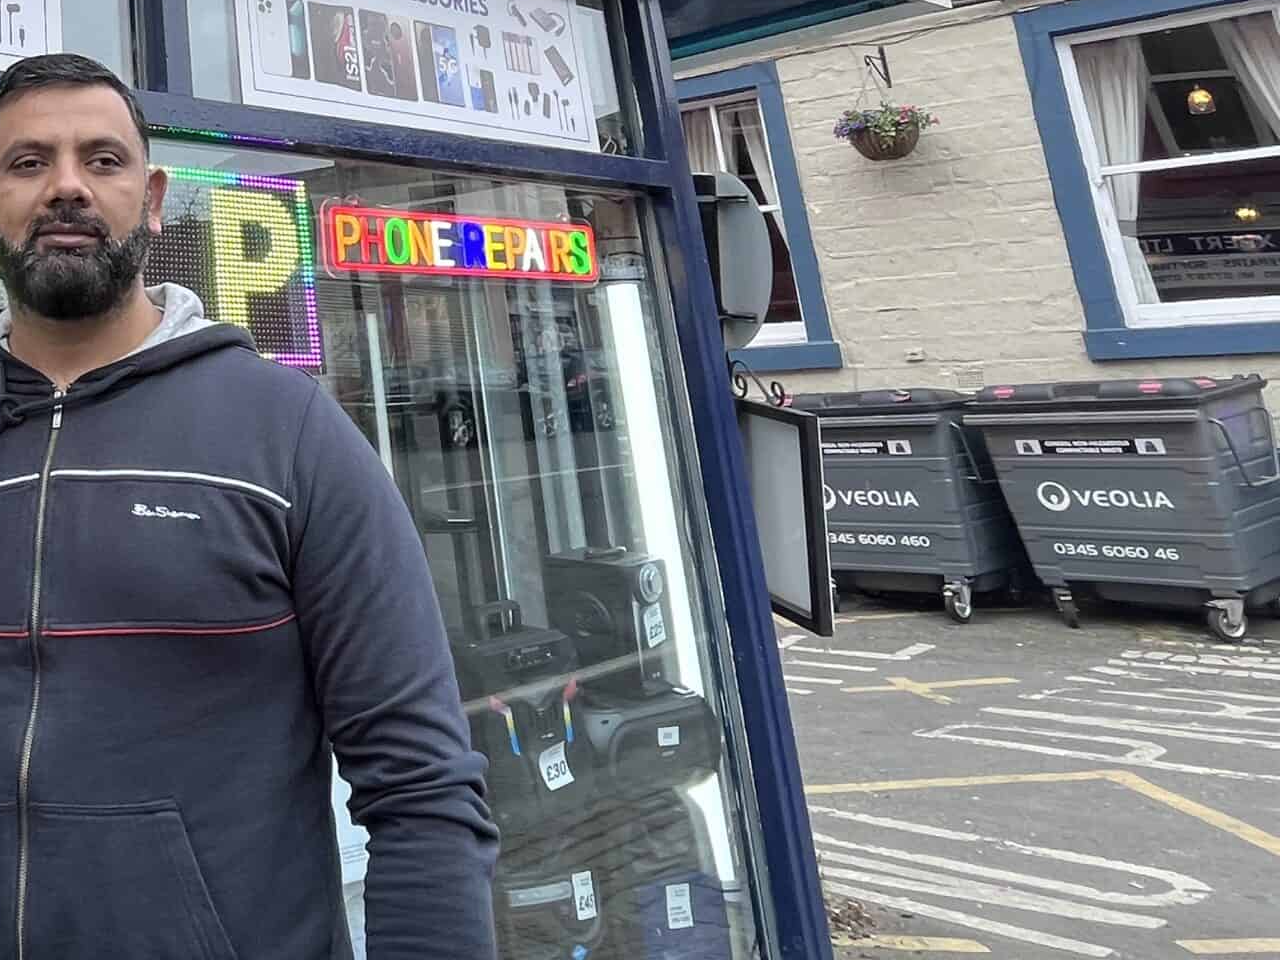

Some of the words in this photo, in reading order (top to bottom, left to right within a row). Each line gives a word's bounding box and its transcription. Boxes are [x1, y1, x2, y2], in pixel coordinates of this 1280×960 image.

[335, 214, 455, 268] PHONE
[461, 220, 590, 276] REPAIRS
[837, 490, 920, 507] VEOLIA
[1071, 489, 1175, 509] VEOLIA
[828, 532, 856, 545] 345
[858, 533, 897, 546] 6060
[900, 535, 931, 548] 460
[1053, 542, 1099, 557] 0345
[1102, 545, 1149, 559] 6060
[1154, 547, 1179, 561] 46
[546, 759, 567, 782] £30
